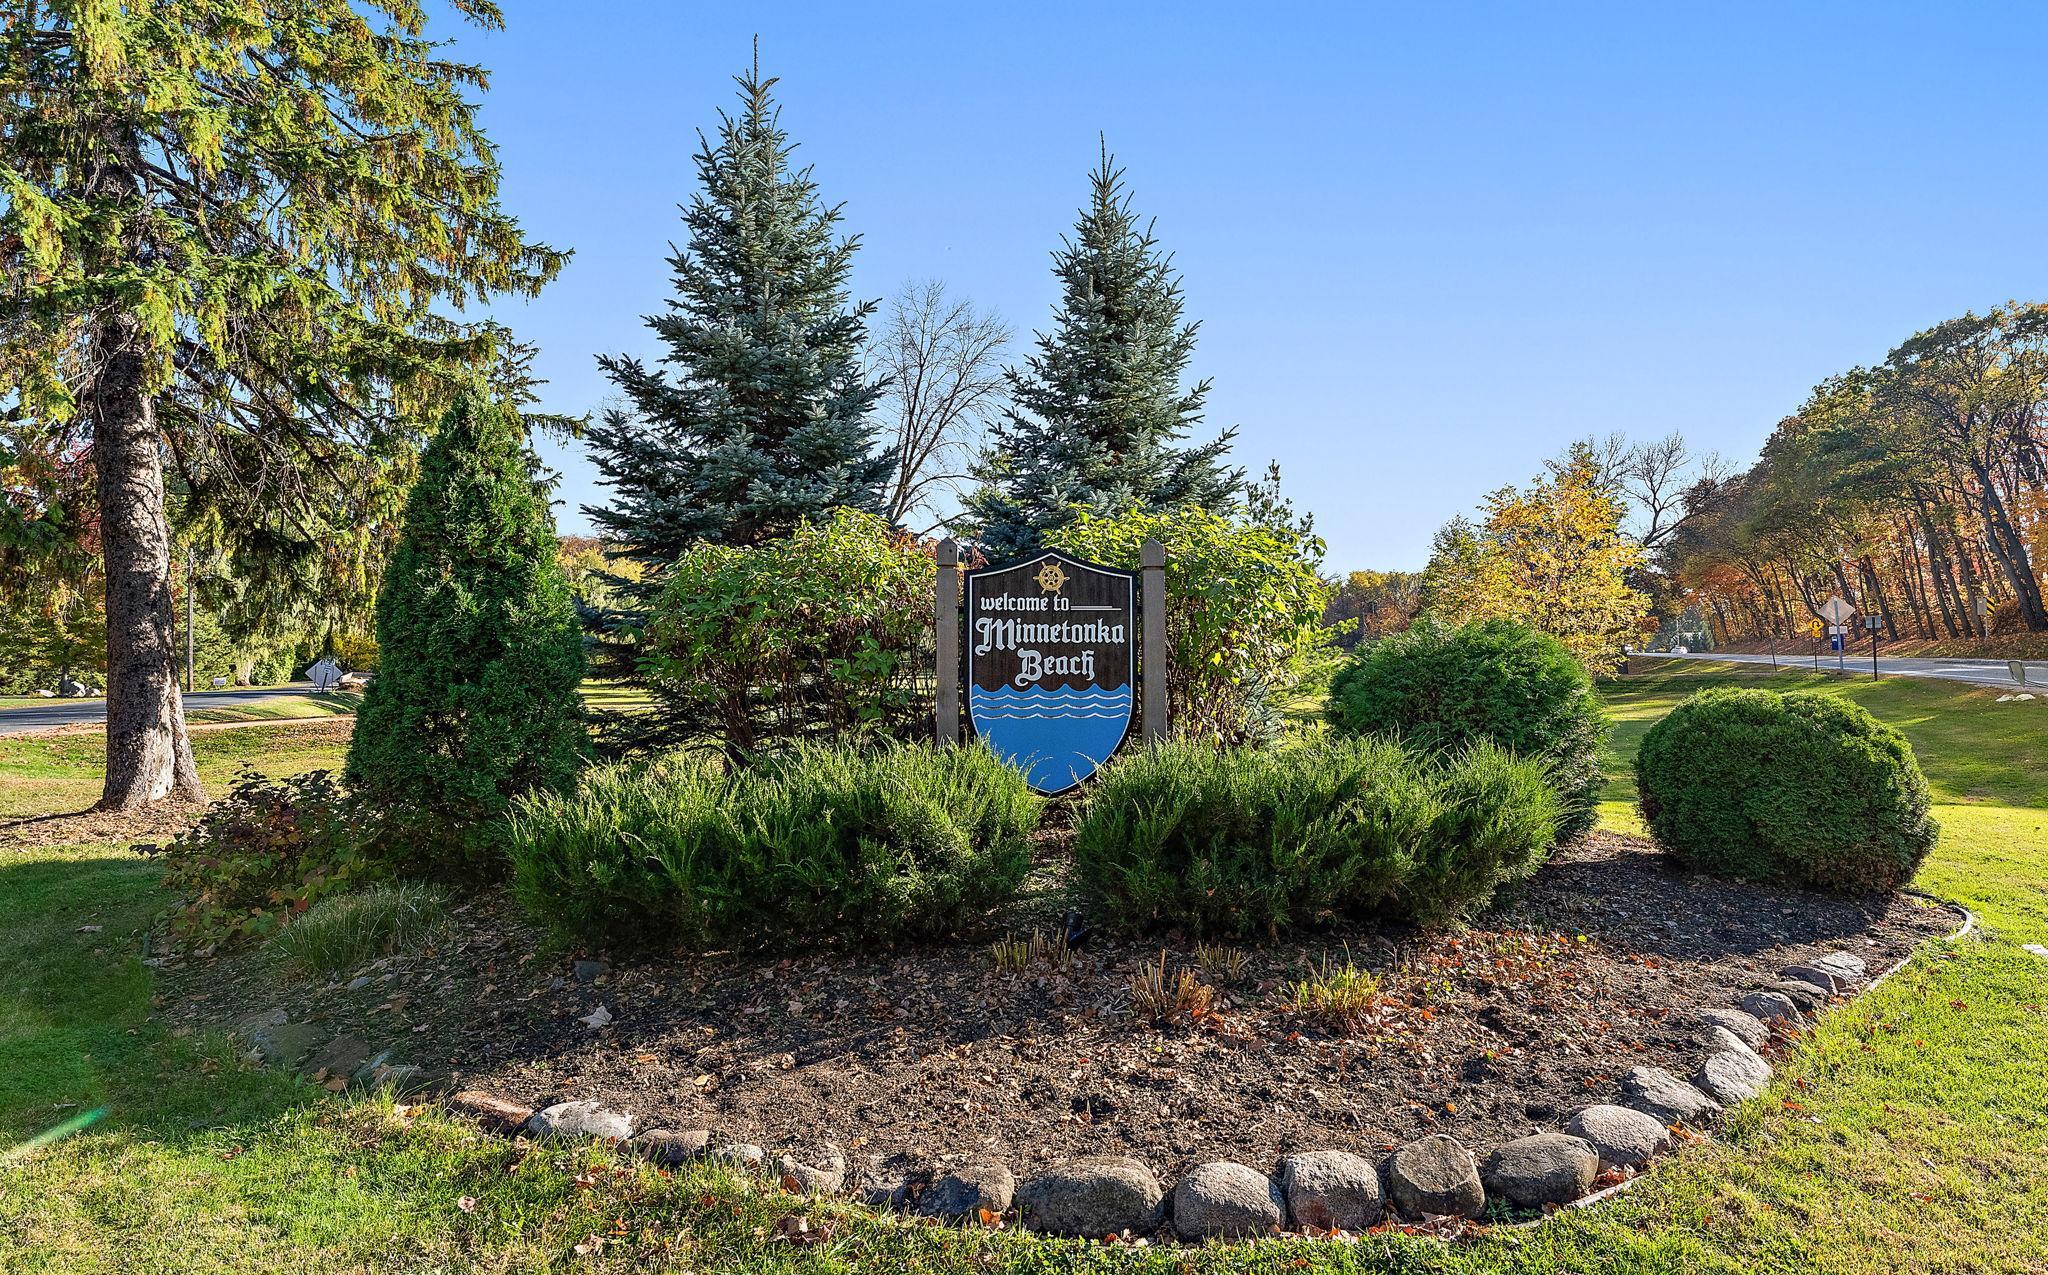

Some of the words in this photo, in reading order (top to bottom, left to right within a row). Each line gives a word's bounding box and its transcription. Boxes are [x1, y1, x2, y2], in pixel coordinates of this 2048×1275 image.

[980, 592, 1048, 611] welcome
[1053, 594, 1070, 612] to
[974, 617, 1125, 656] Minnetonka
[1014, 648, 1095, 687] Beach
